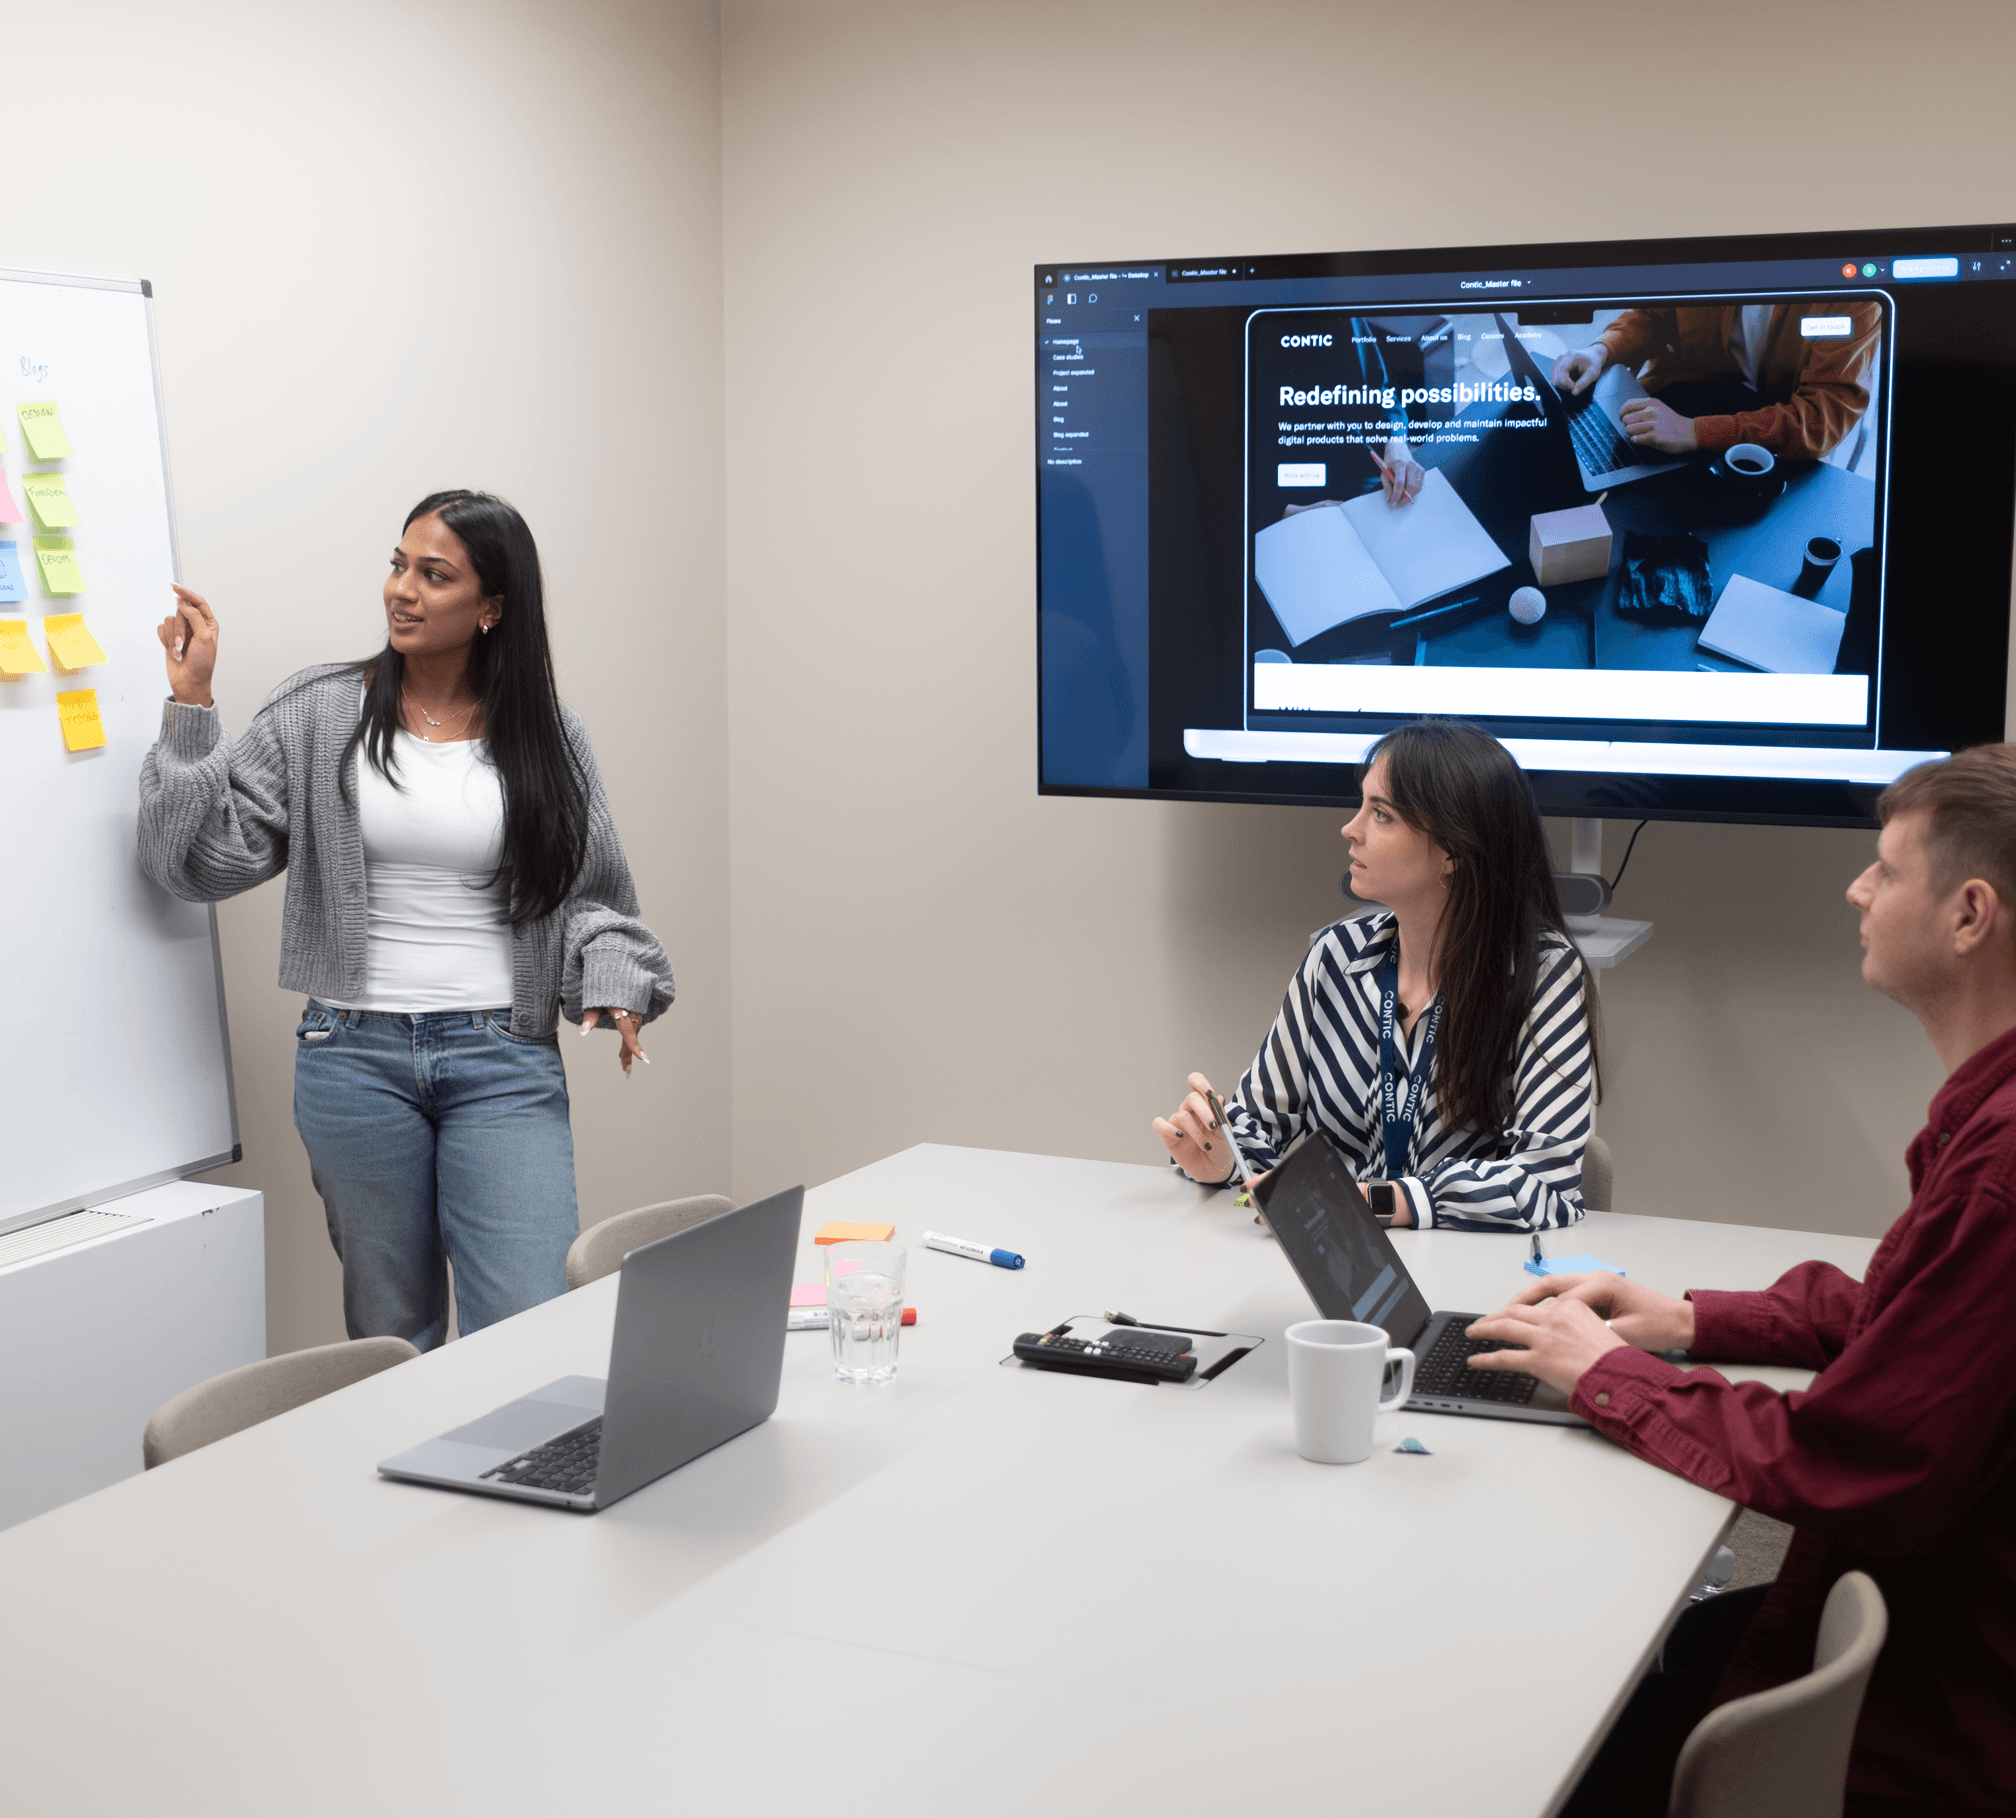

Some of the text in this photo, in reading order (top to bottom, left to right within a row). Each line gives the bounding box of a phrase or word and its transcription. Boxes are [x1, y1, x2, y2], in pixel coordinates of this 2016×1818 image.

[1460, 279, 1522, 289] Contic_Master file
[1280, 334, 1332, 347] CONTIC
[1351, 336, 1376, 344] Portfolio
[1457, 333, 1471, 342] Blog
[1514, 332, 1542, 340] Academy
[1280, 382, 1541, 408] Redefining possibilities.
[21, 408, 54, 420] DESIGN
[1278, 418, 1547, 433] We partner with you to design, develop and maintain impactful
[1278, 433, 1479, 446] digital products that solve real-world problems.
[1382, 990, 1394, 1039] CONTIC
[1384, 1072, 1396, 1123] CONTIC
[1403, 1074, 1422, 1122] CONTIC
